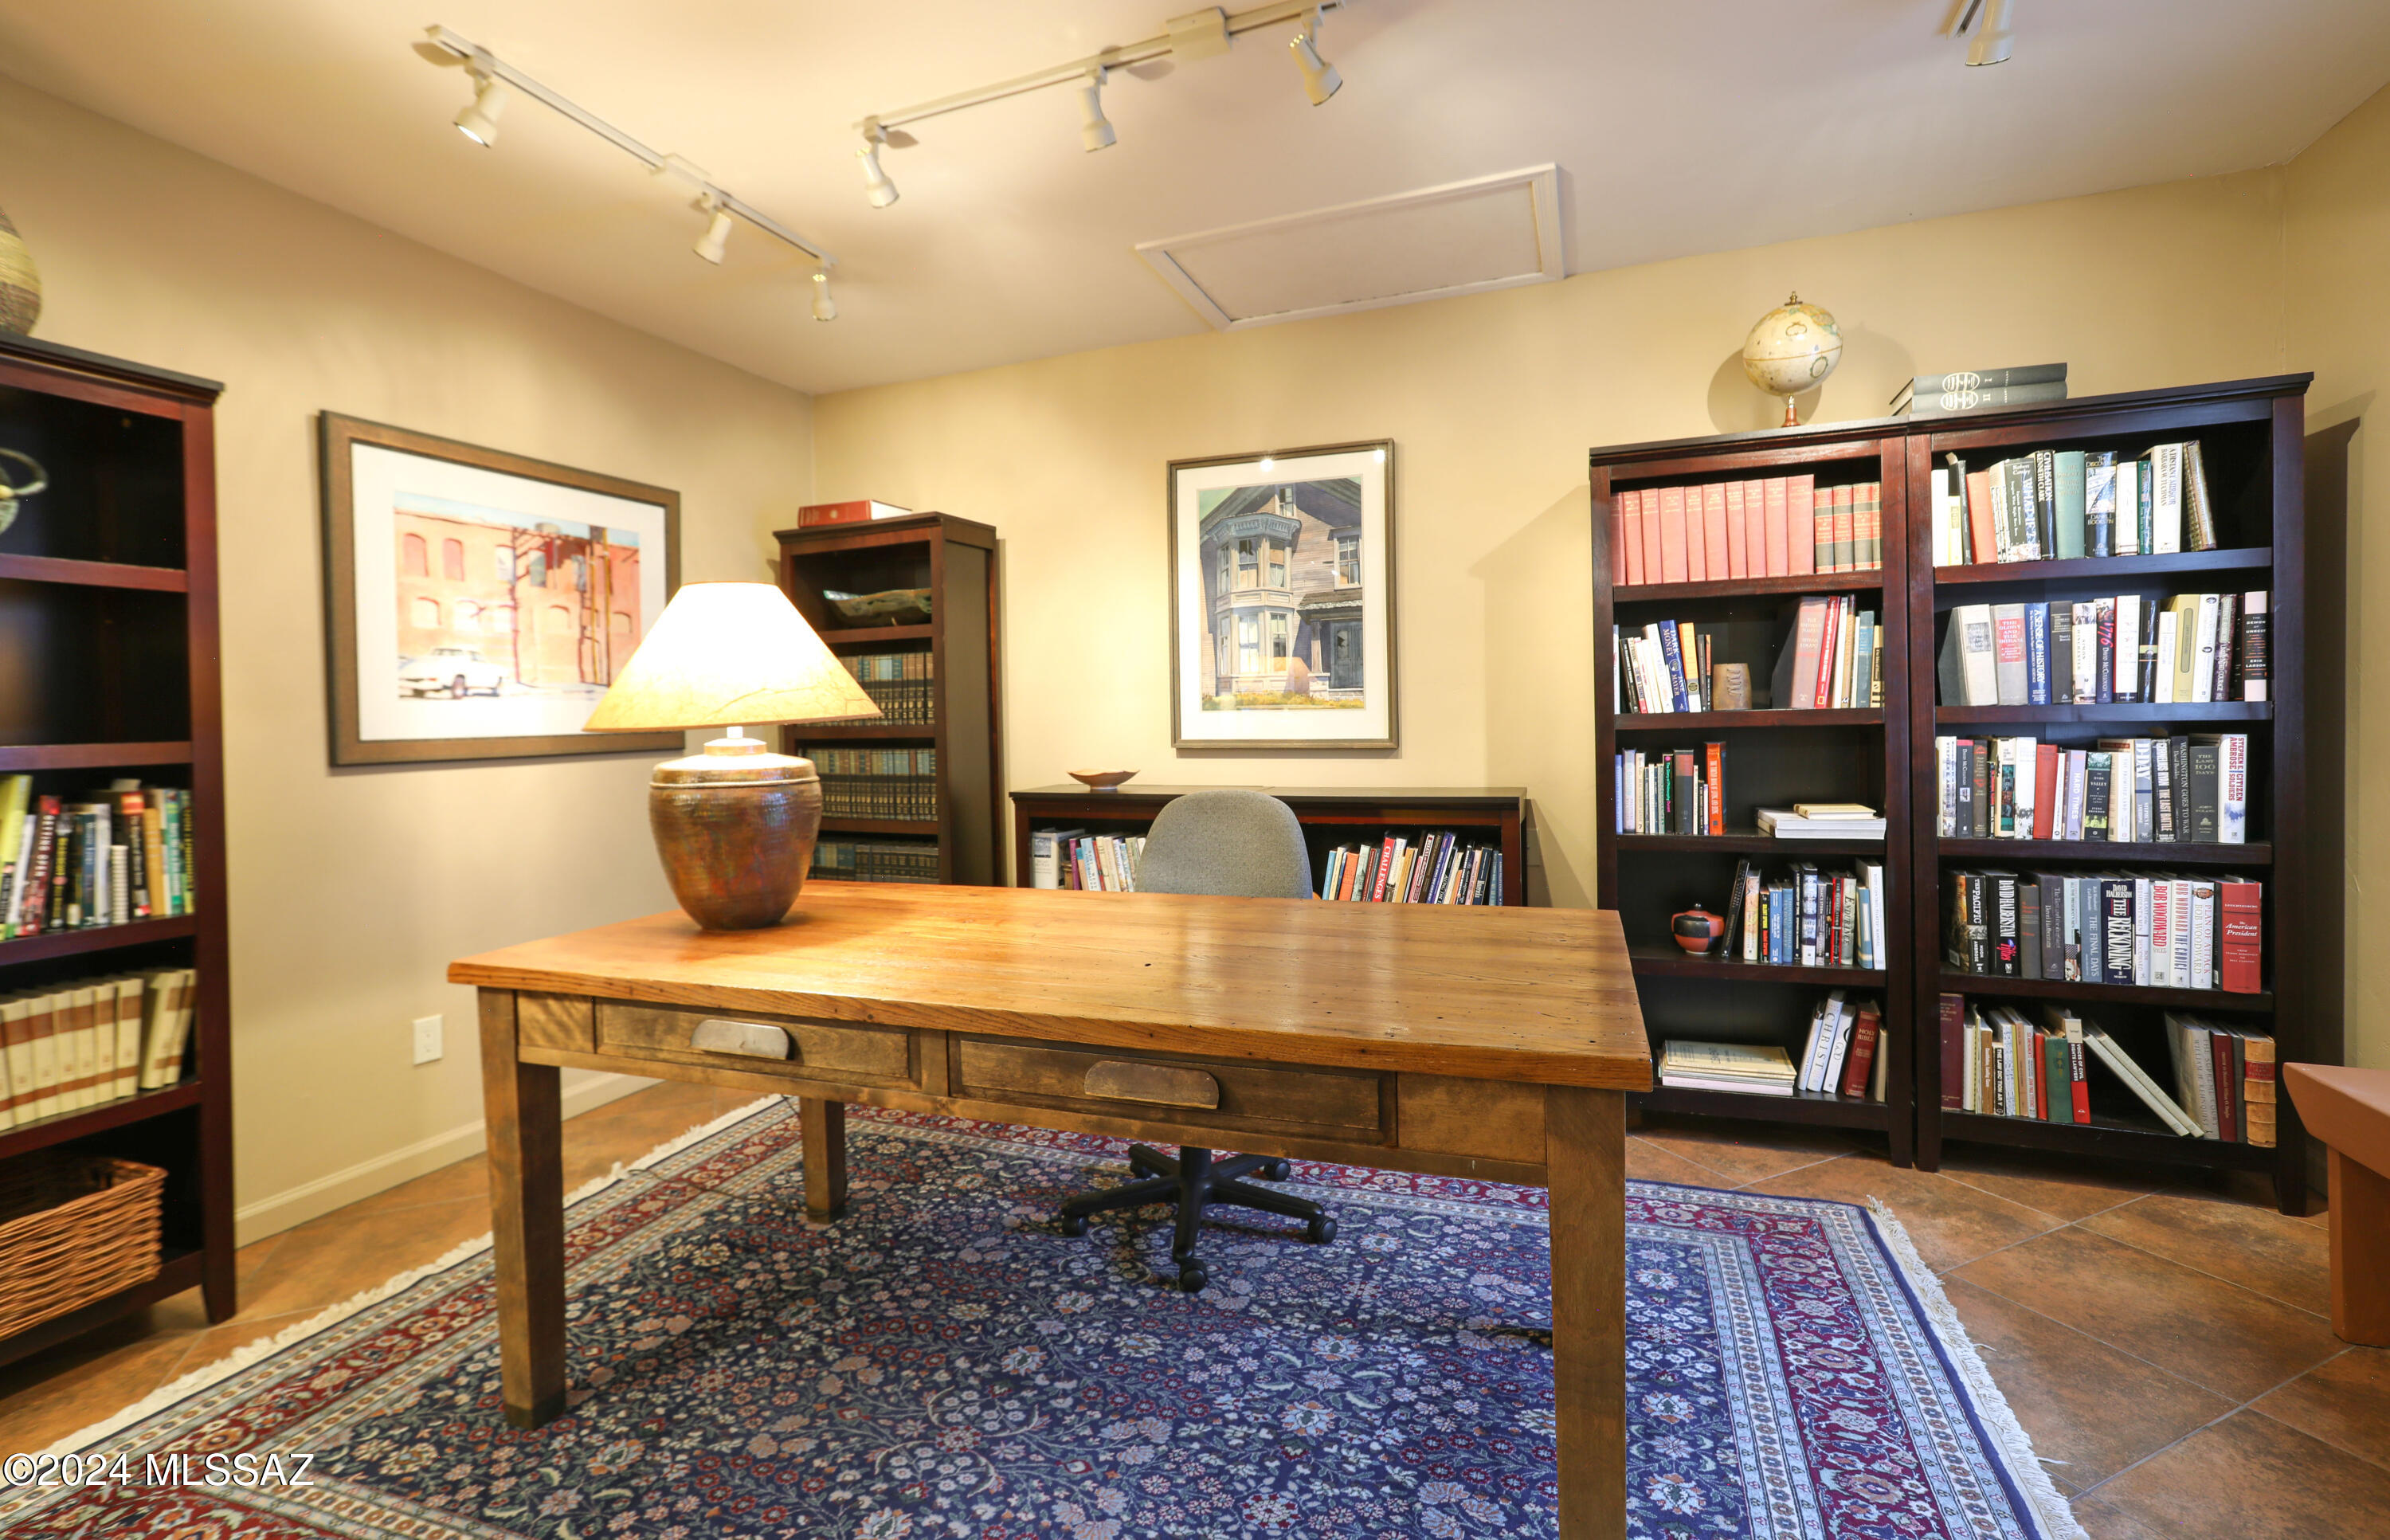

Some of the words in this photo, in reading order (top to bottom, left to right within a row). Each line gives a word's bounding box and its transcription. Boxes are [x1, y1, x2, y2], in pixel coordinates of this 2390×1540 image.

[2043, 451, 2053, 501] CIVILISATION
[2022, 476, 2035, 515] WHAT
[2035, 616, 2043, 640] SENSE
[2097, 622, 2114, 648] 1776
[1663, 628, 1674, 657] MONEY
[1670, 629, 1679, 655] DARK
[2035, 640, 2044, 651] OF
[2036, 652, 2046, 683] HISTORY
[1671, 674, 1680, 696] MAYER
[2136, 743, 2151, 780] D-DAY
[2159, 789, 2171, 799] THE
[2160, 799, 2172, 812] LAST
[2071, 796, 2080, 820] TIMES
[2182, 808, 2188, 818] TO
[37, 814, 57, 852] GETTING
[2161, 813, 2173, 831] BATTLE
[34, 852, 49, 877] OPEN
[1374, 846, 1392, 899] CHALLENGES
[1998, 880, 2015, 898] DAVID
[2153, 885, 2168, 901] BOB
[2176, 883, 2188, 895] BOB
[1973, 889, 1982, 924] PACIFIC
[1999, 898, 2016, 937] HALBERSTAM
[2113, 899, 2127, 916] THE
[2175, 897, 2188, 932] WOODWARD
[1843, 895, 1855, 945] ENDURANCE
[2089, 915, 2098, 931] THE
[2153, 903, 2168, 946] WOODWARD
[2108, 916, 2132, 970] RECKONING
[2175, 935, 2188, 946] THE
[2204, 928, 2212, 938] OF
[2174, 947, 2188, 970] CHOICE
[2193, 923, 2203, 974] WOODWARD
[2090, 958, 2099, 977] DAYS
[1815, 1013, 1836, 1070] CHRIST
[2205, 1058, 2215, 1095] SUPREME
